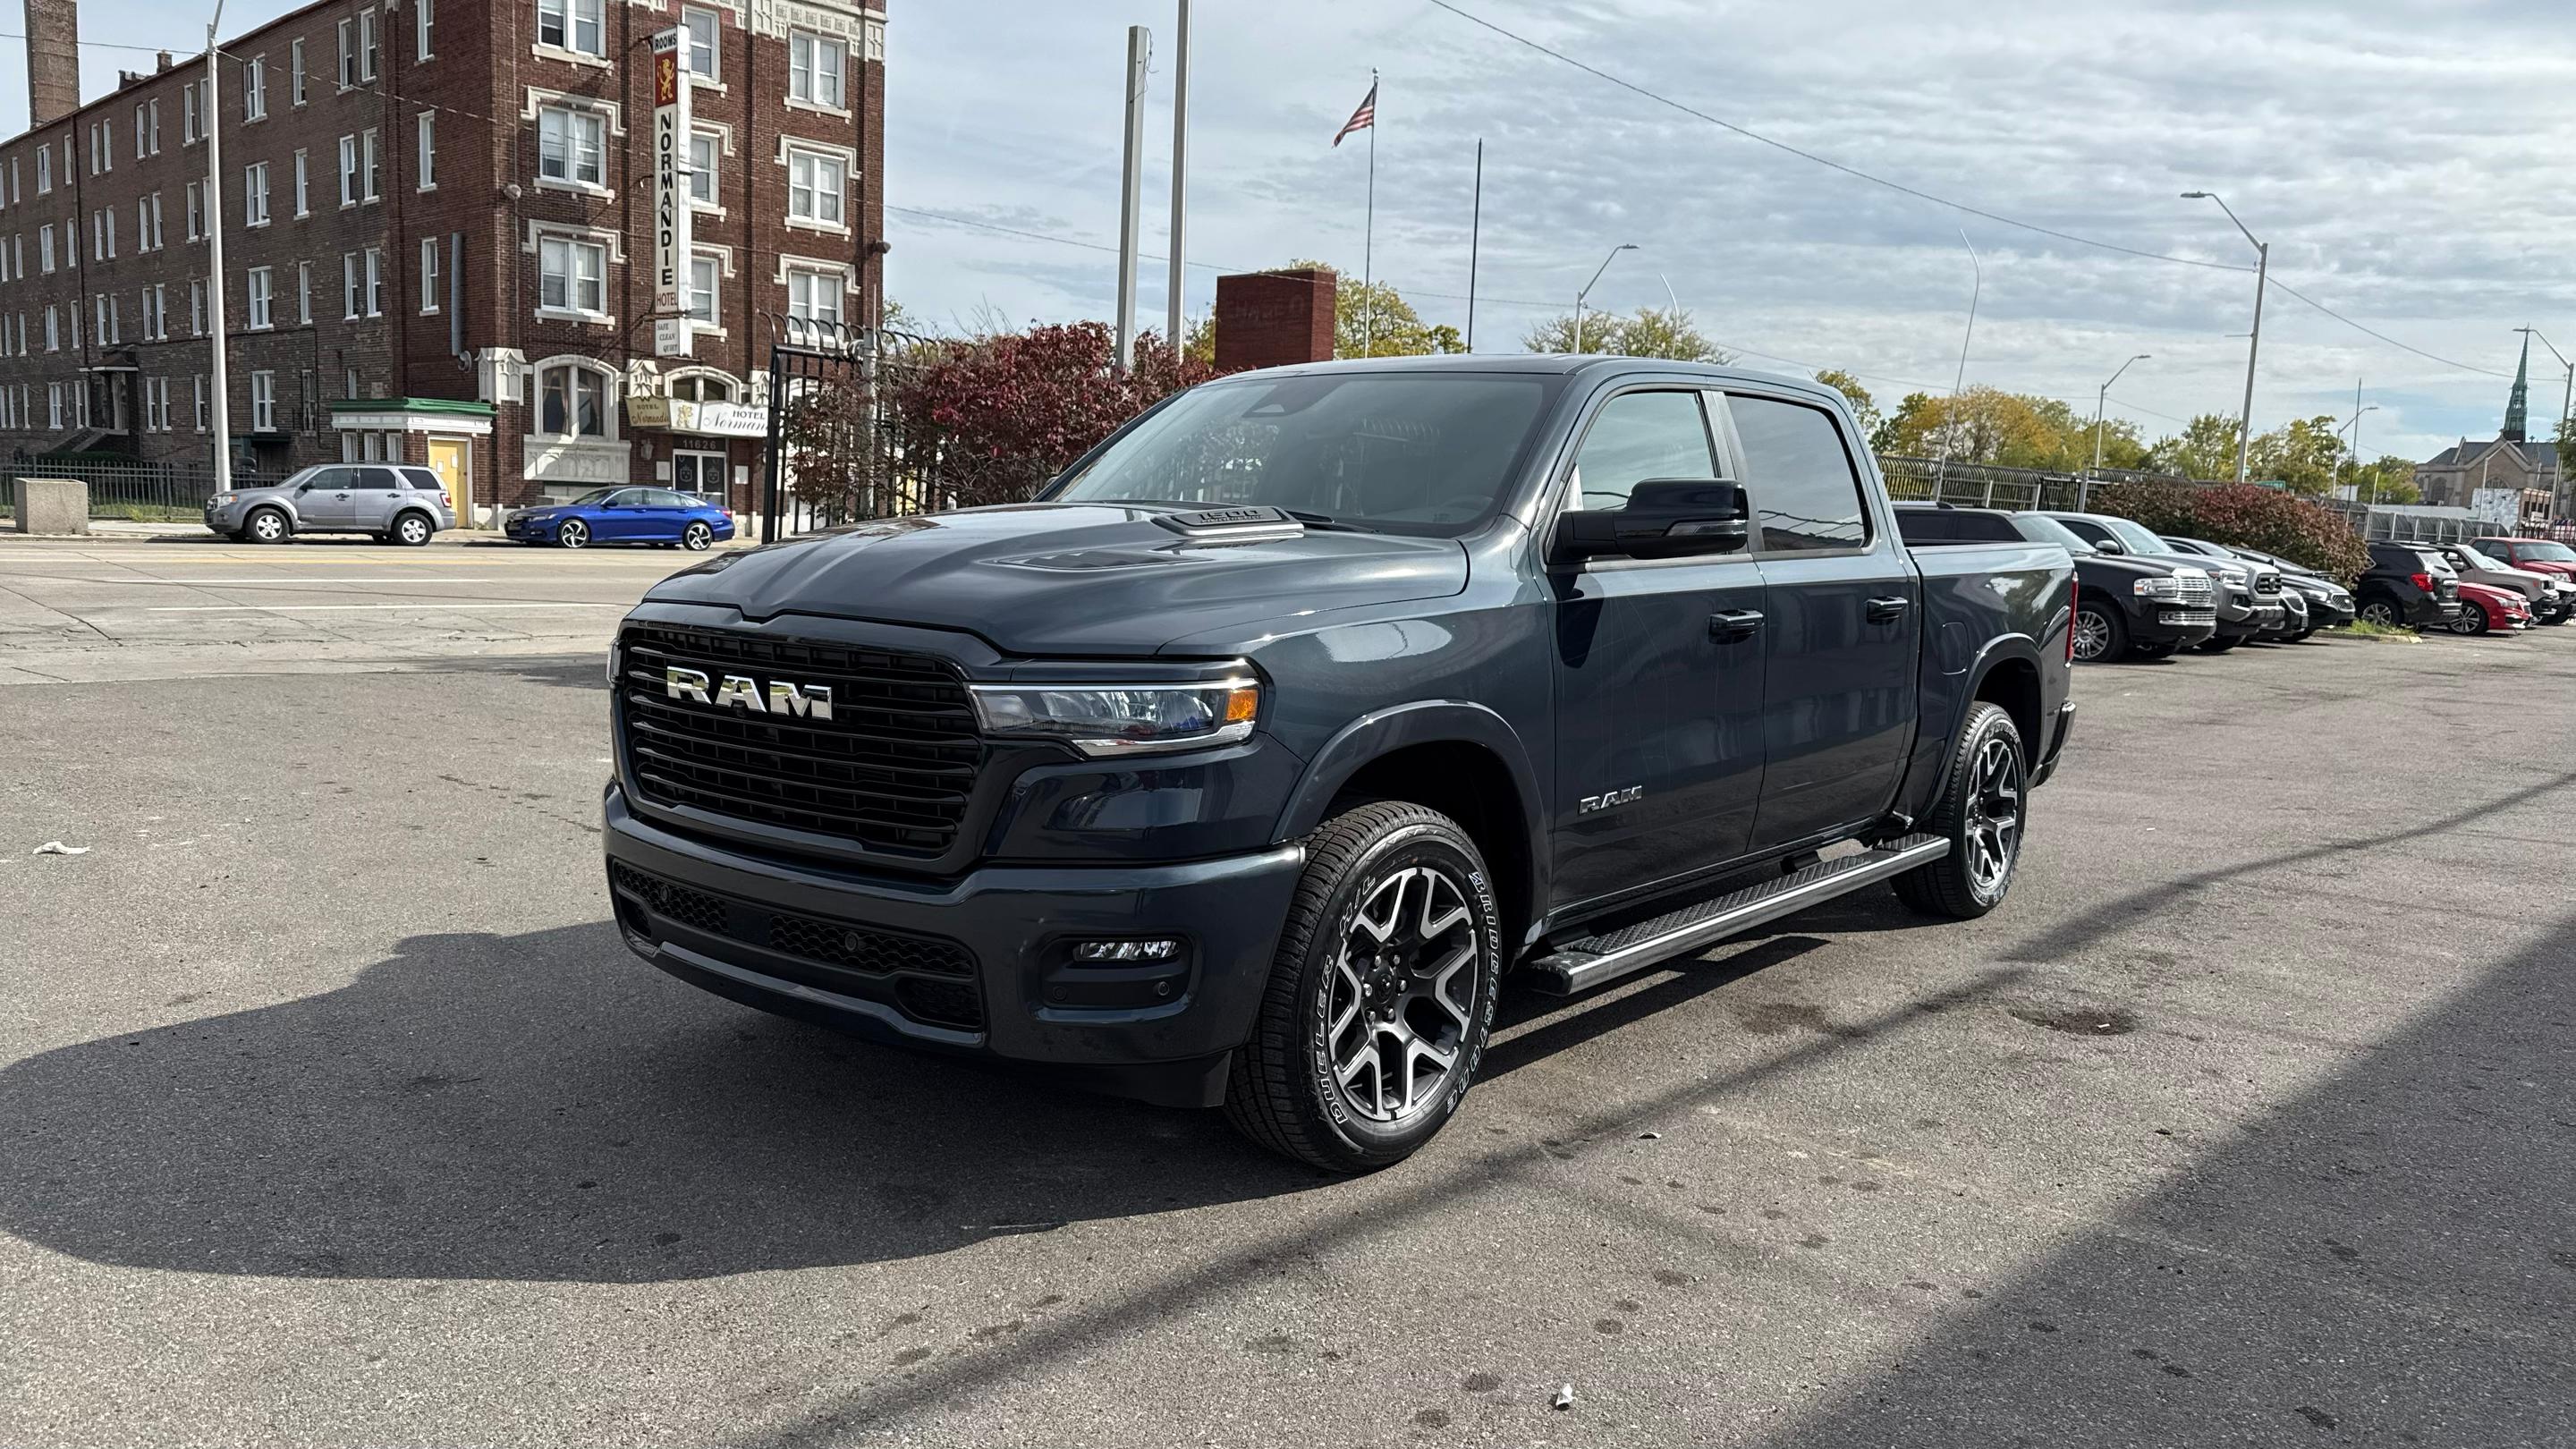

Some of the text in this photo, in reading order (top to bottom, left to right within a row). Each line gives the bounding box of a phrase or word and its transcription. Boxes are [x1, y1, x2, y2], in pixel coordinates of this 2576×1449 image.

[655, 33, 676, 50] ROOMS
[660, 113, 673, 285] NORMANDIE
[657, 292, 677, 307] HOTEL
[663, 343, 677, 353] QUIET
[703, 412, 768, 431] Norman
[733, 411, 766, 419] HOTEL
[682, 438, 716, 450] 11626
[666, 665, 833, 721] RAM
[1580, 785, 1642, 815] RAM
[1446, 871, 1498, 1114] BRIDGESTONE
[1315, 953, 1349, 1124] DUELER
